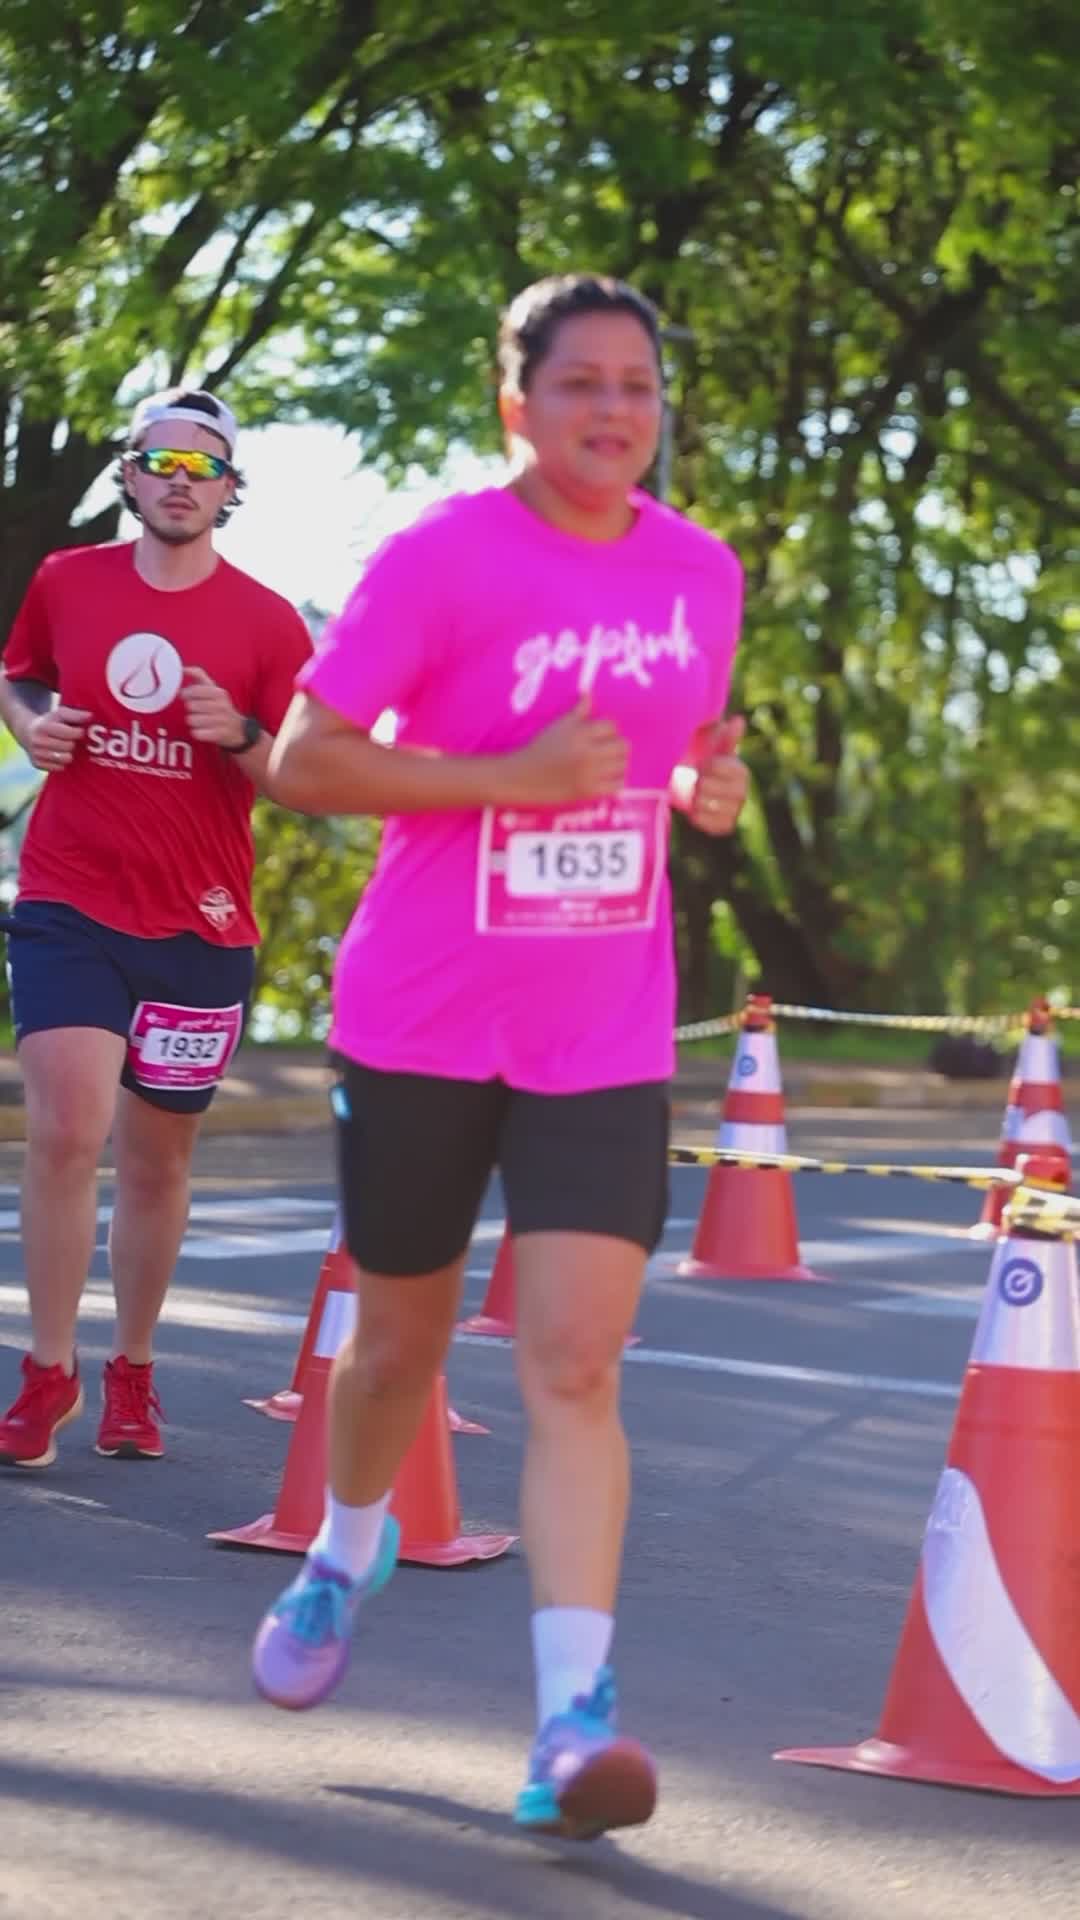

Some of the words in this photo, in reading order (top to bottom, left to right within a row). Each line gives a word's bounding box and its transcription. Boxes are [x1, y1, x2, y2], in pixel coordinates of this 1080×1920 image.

[87, 720, 192, 768] sabin
[529, 841, 628, 879] 1635
[160, 1035, 218, 1058] 1932
